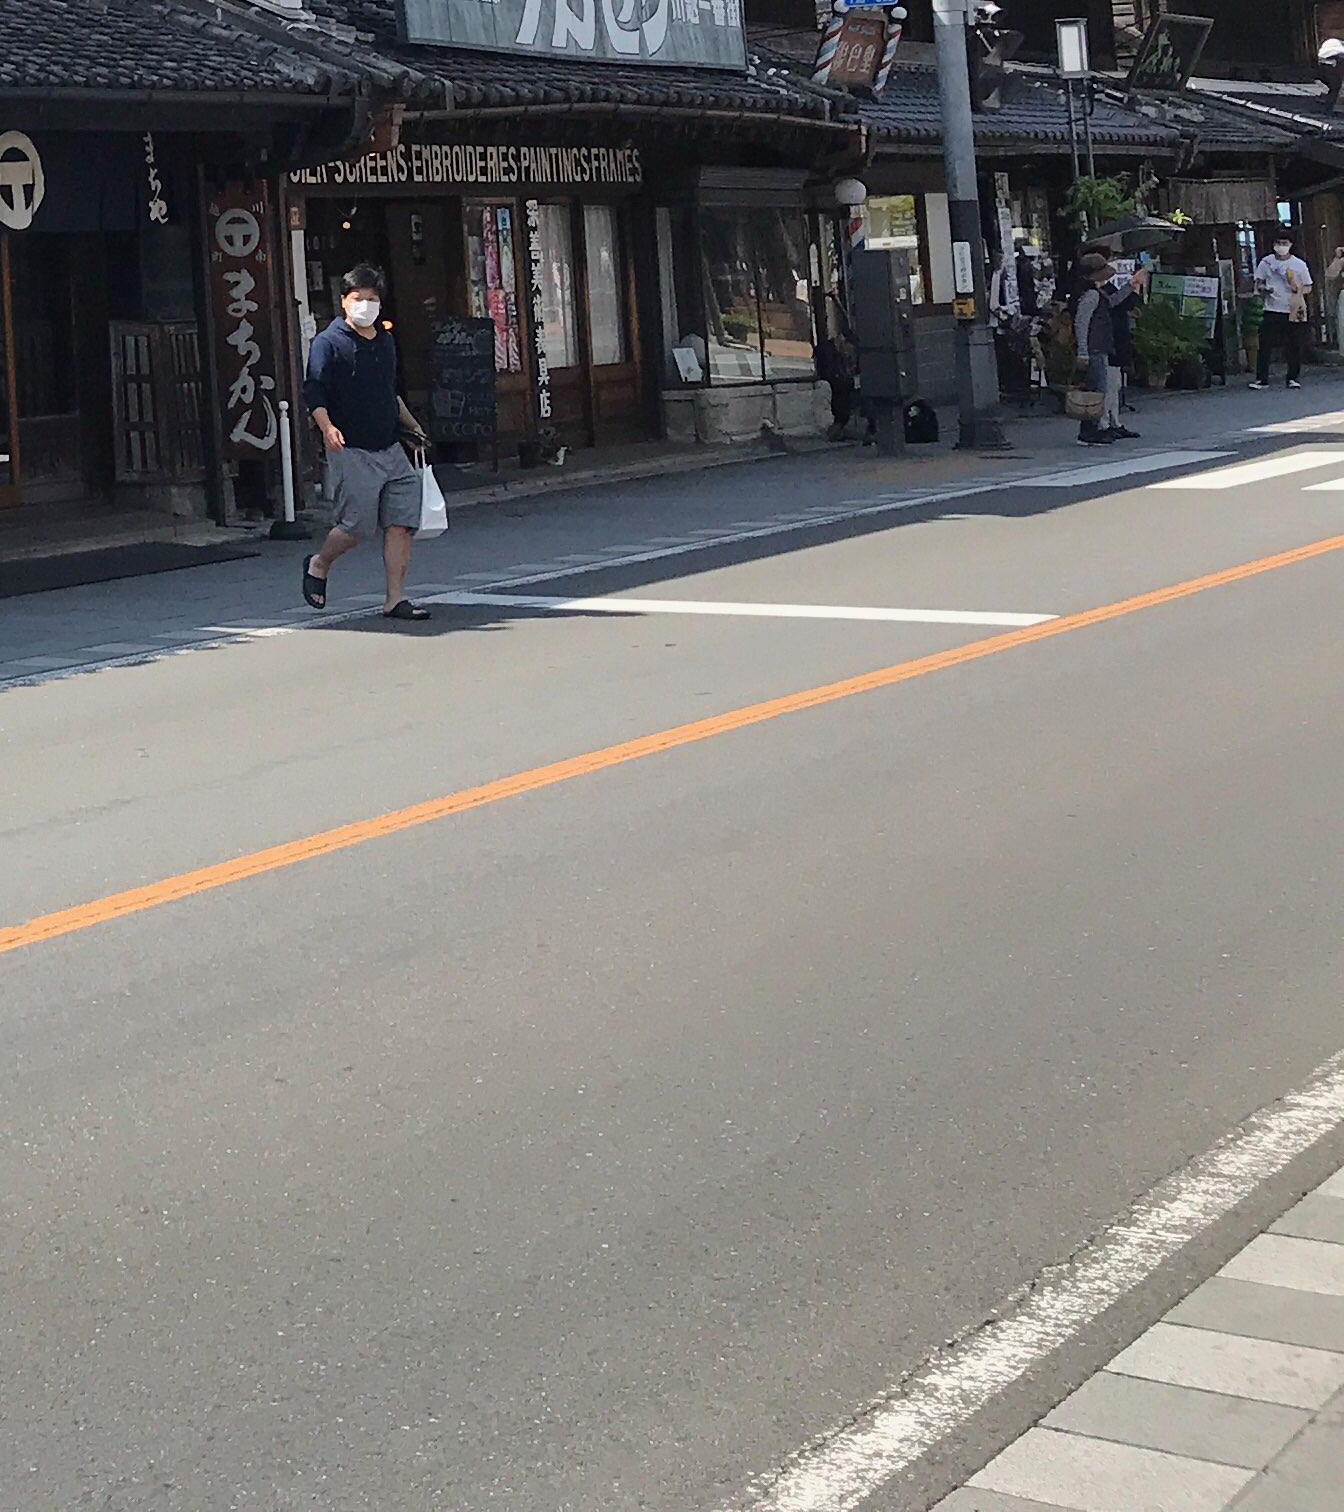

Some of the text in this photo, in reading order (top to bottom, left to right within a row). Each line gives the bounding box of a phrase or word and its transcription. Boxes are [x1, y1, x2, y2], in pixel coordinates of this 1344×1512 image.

[520, 145, 590, 183] PAINTINGS
[590, 146, 643, 183] FRAMES
[222, 267, 278, 451] まちかん
